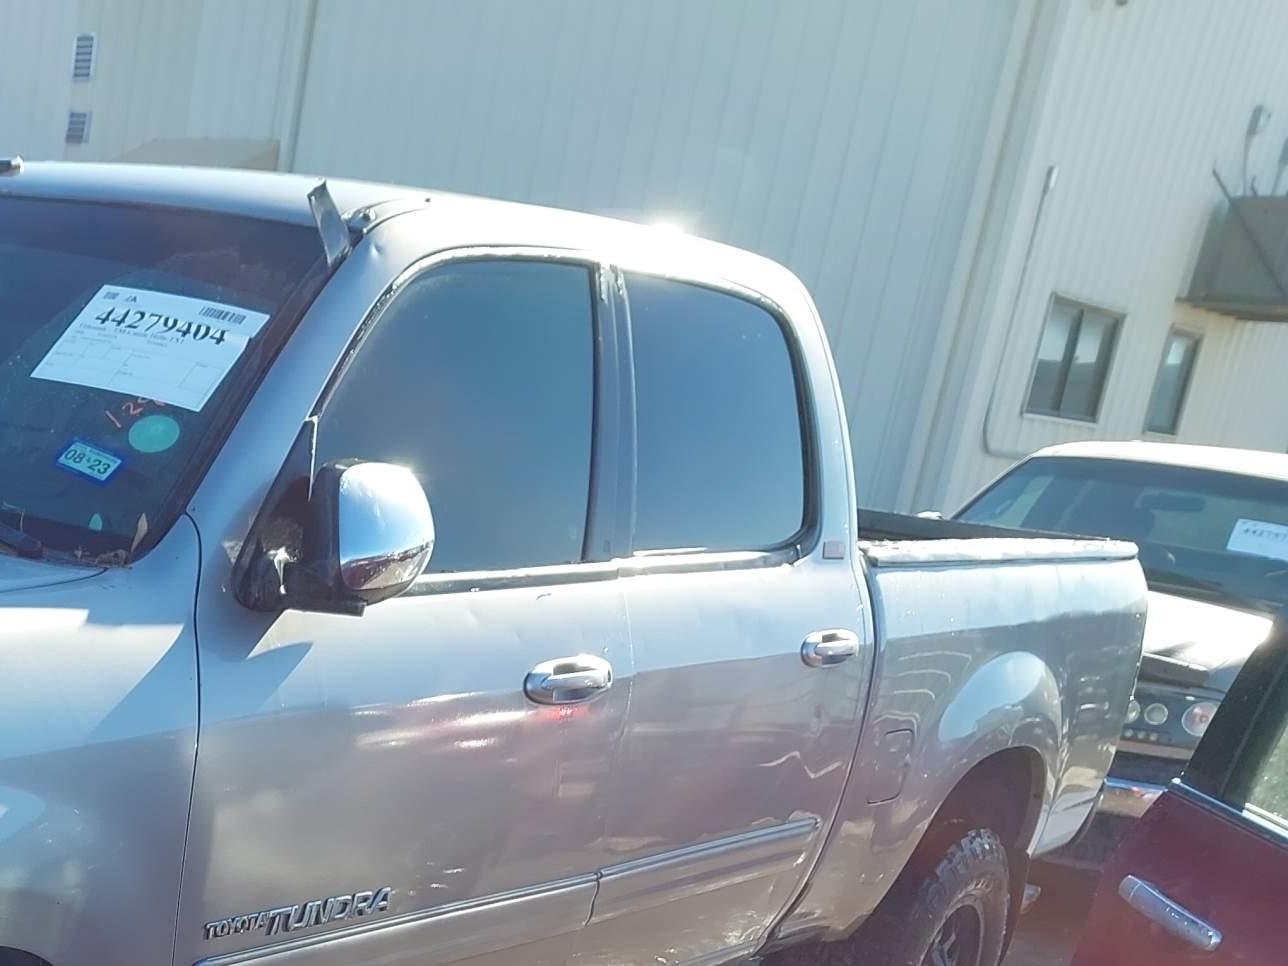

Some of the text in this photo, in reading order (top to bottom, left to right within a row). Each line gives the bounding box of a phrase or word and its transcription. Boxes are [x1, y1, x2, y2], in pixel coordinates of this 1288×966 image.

[96, 307, 228, 346] 44279404
[64, 449, 86, 464] 08
[87, 458, 112, 475] 23
[205, 886, 392, 940] TOYOTA TUNDRA
